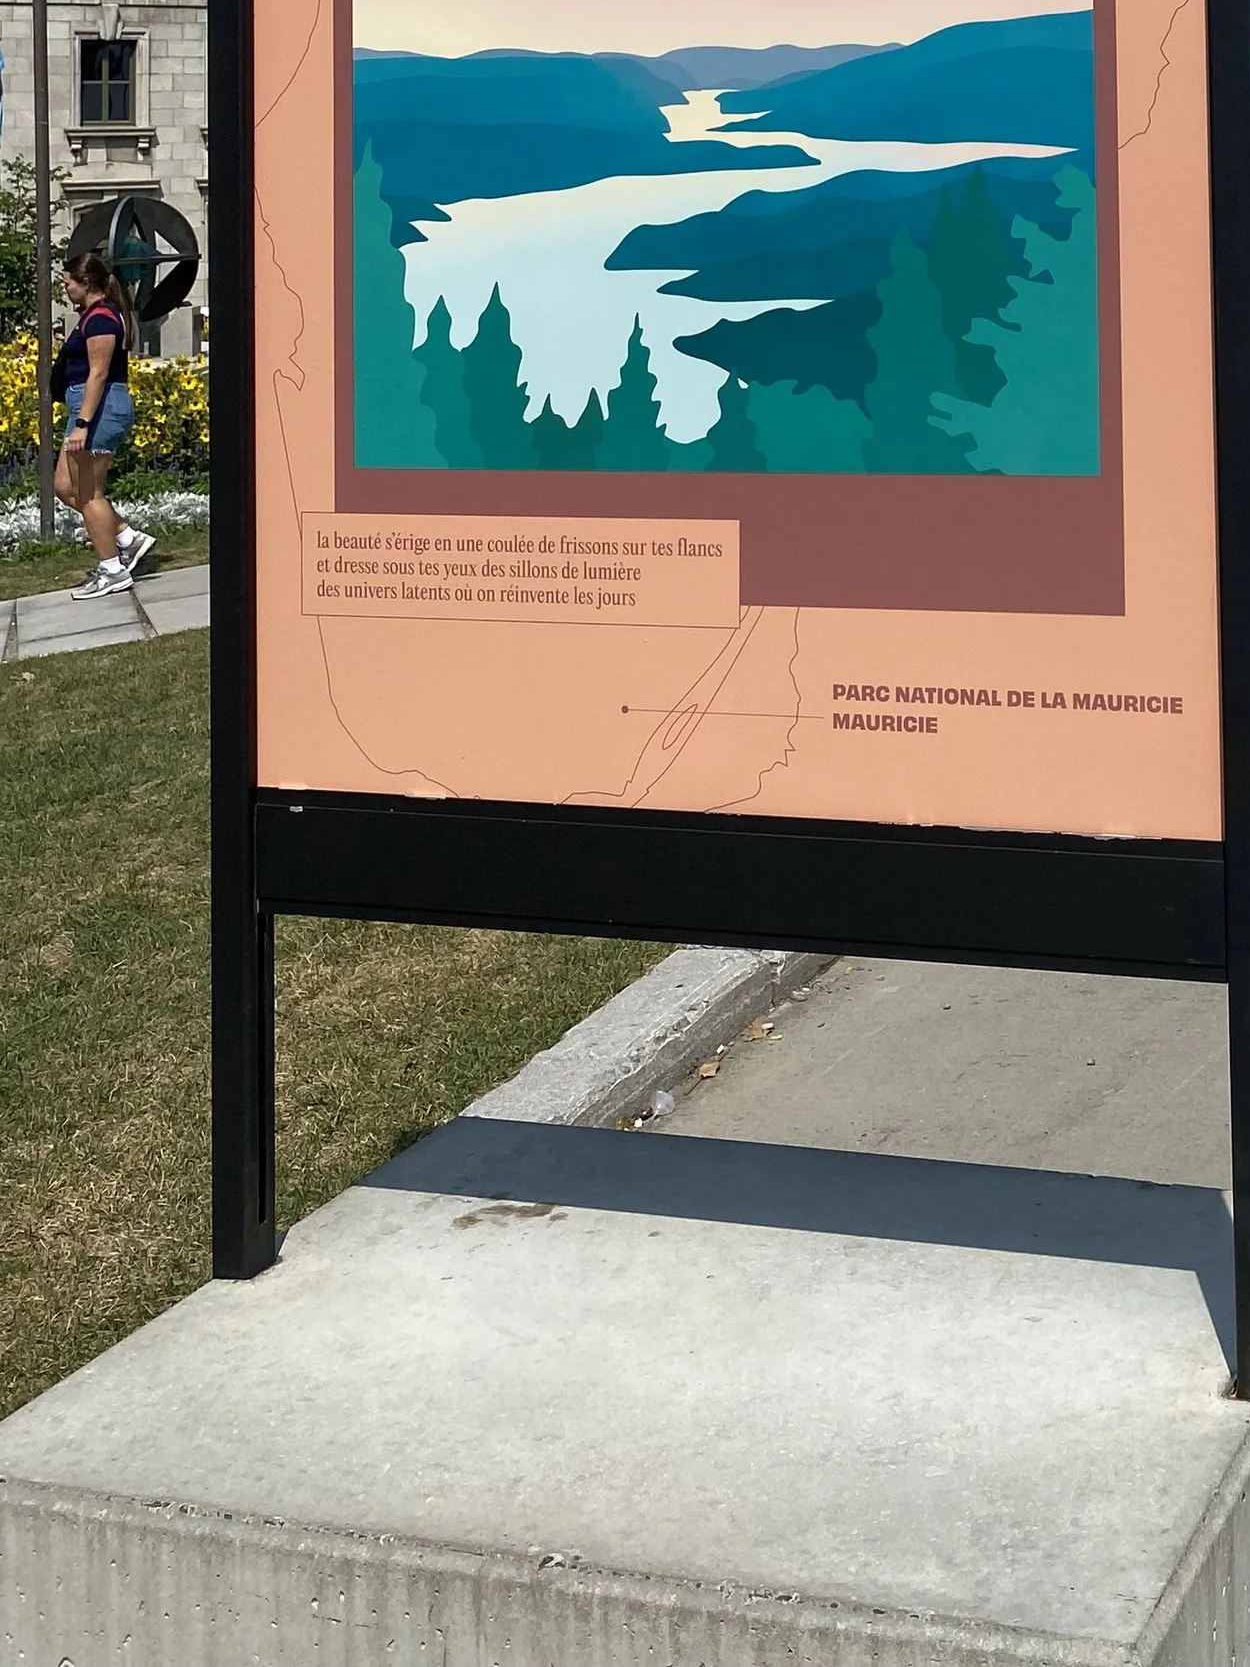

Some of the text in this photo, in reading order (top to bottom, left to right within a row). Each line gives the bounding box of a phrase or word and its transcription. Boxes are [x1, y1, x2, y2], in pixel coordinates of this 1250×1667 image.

[317, 531, 723, 557] la beauté s'érige en une coulée de frissons sur tes flancs
[317, 556, 641, 581] et dresse sous tes yeux des sillons de lumière
[317, 580, 636, 610] des univers latents où on réinvente les jours
[832, 684, 1184, 714] PARC NATIONAL DE LA MAURICIE
[832, 713, 938, 733] MAURICIE
